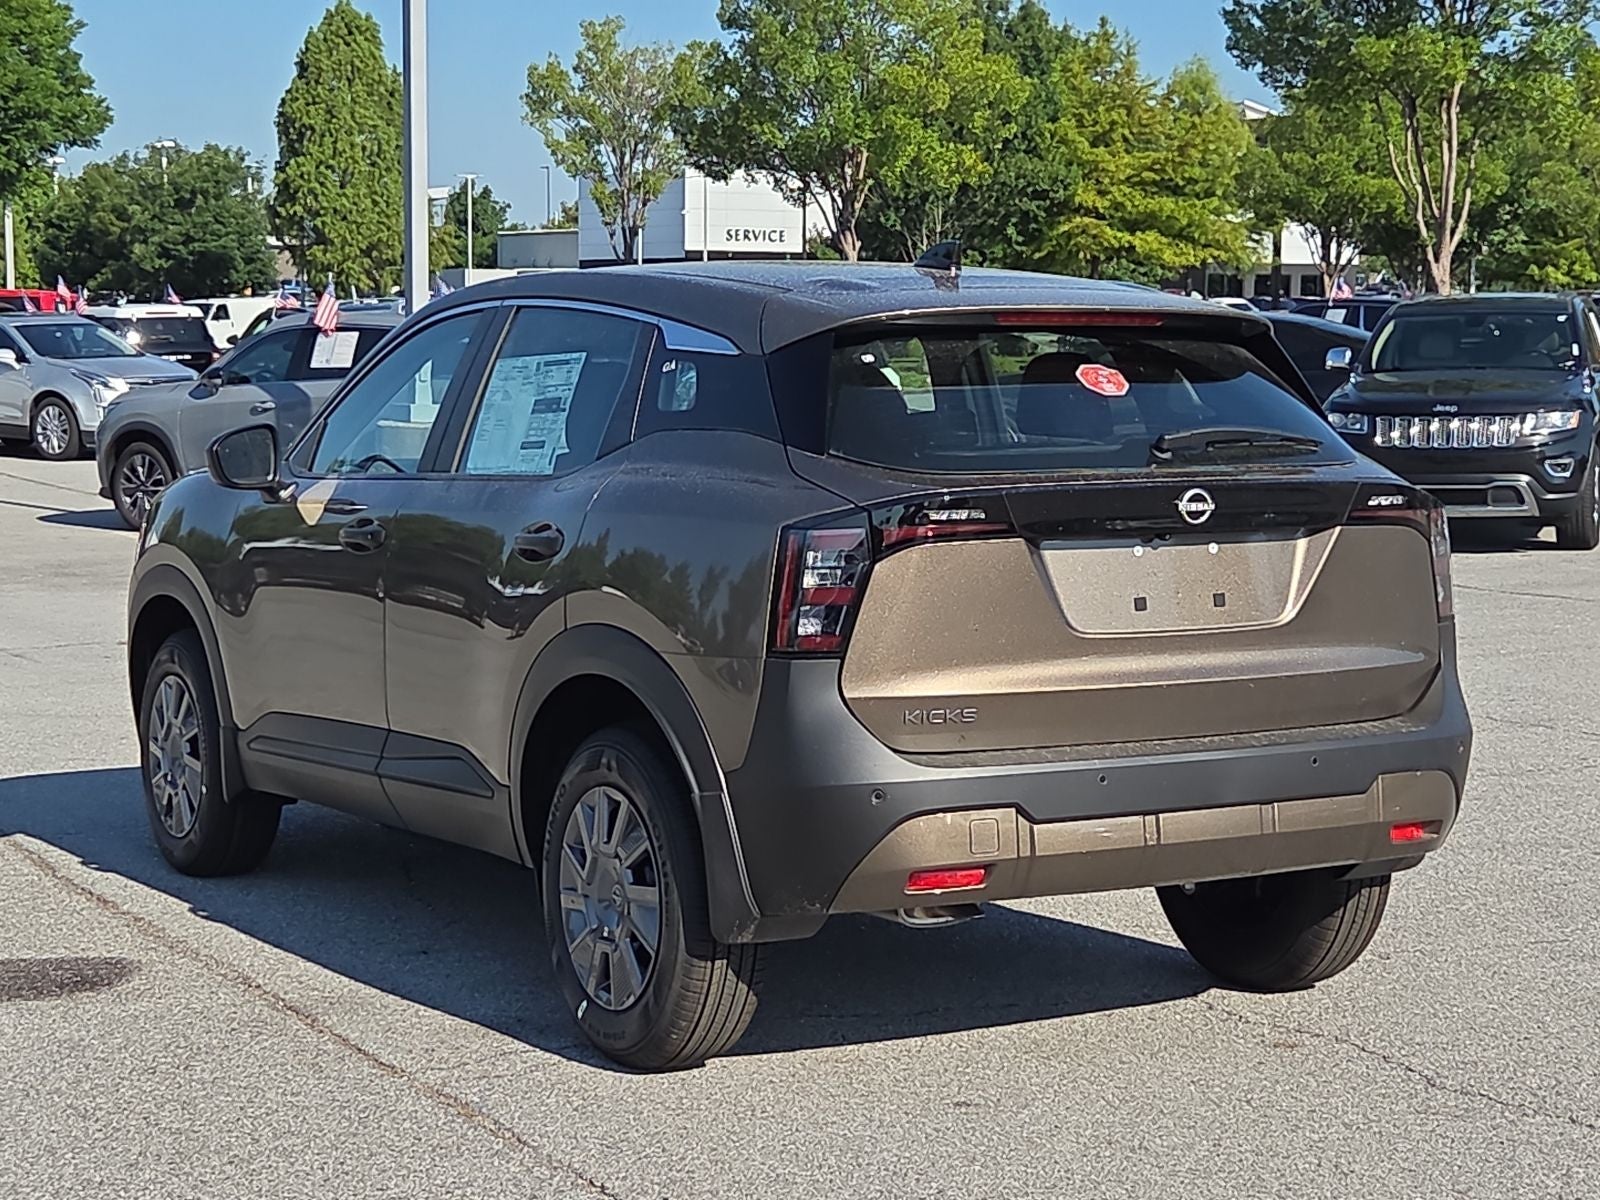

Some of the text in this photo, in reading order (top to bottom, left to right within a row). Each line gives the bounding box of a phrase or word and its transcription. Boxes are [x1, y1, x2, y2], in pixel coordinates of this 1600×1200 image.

[725, 228, 786, 242] SERVICE
[1432, 403, 1458, 413] Jeep
[1178, 501, 1216, 512] NISSAN
[903, 708, 978, 725] KICKS
